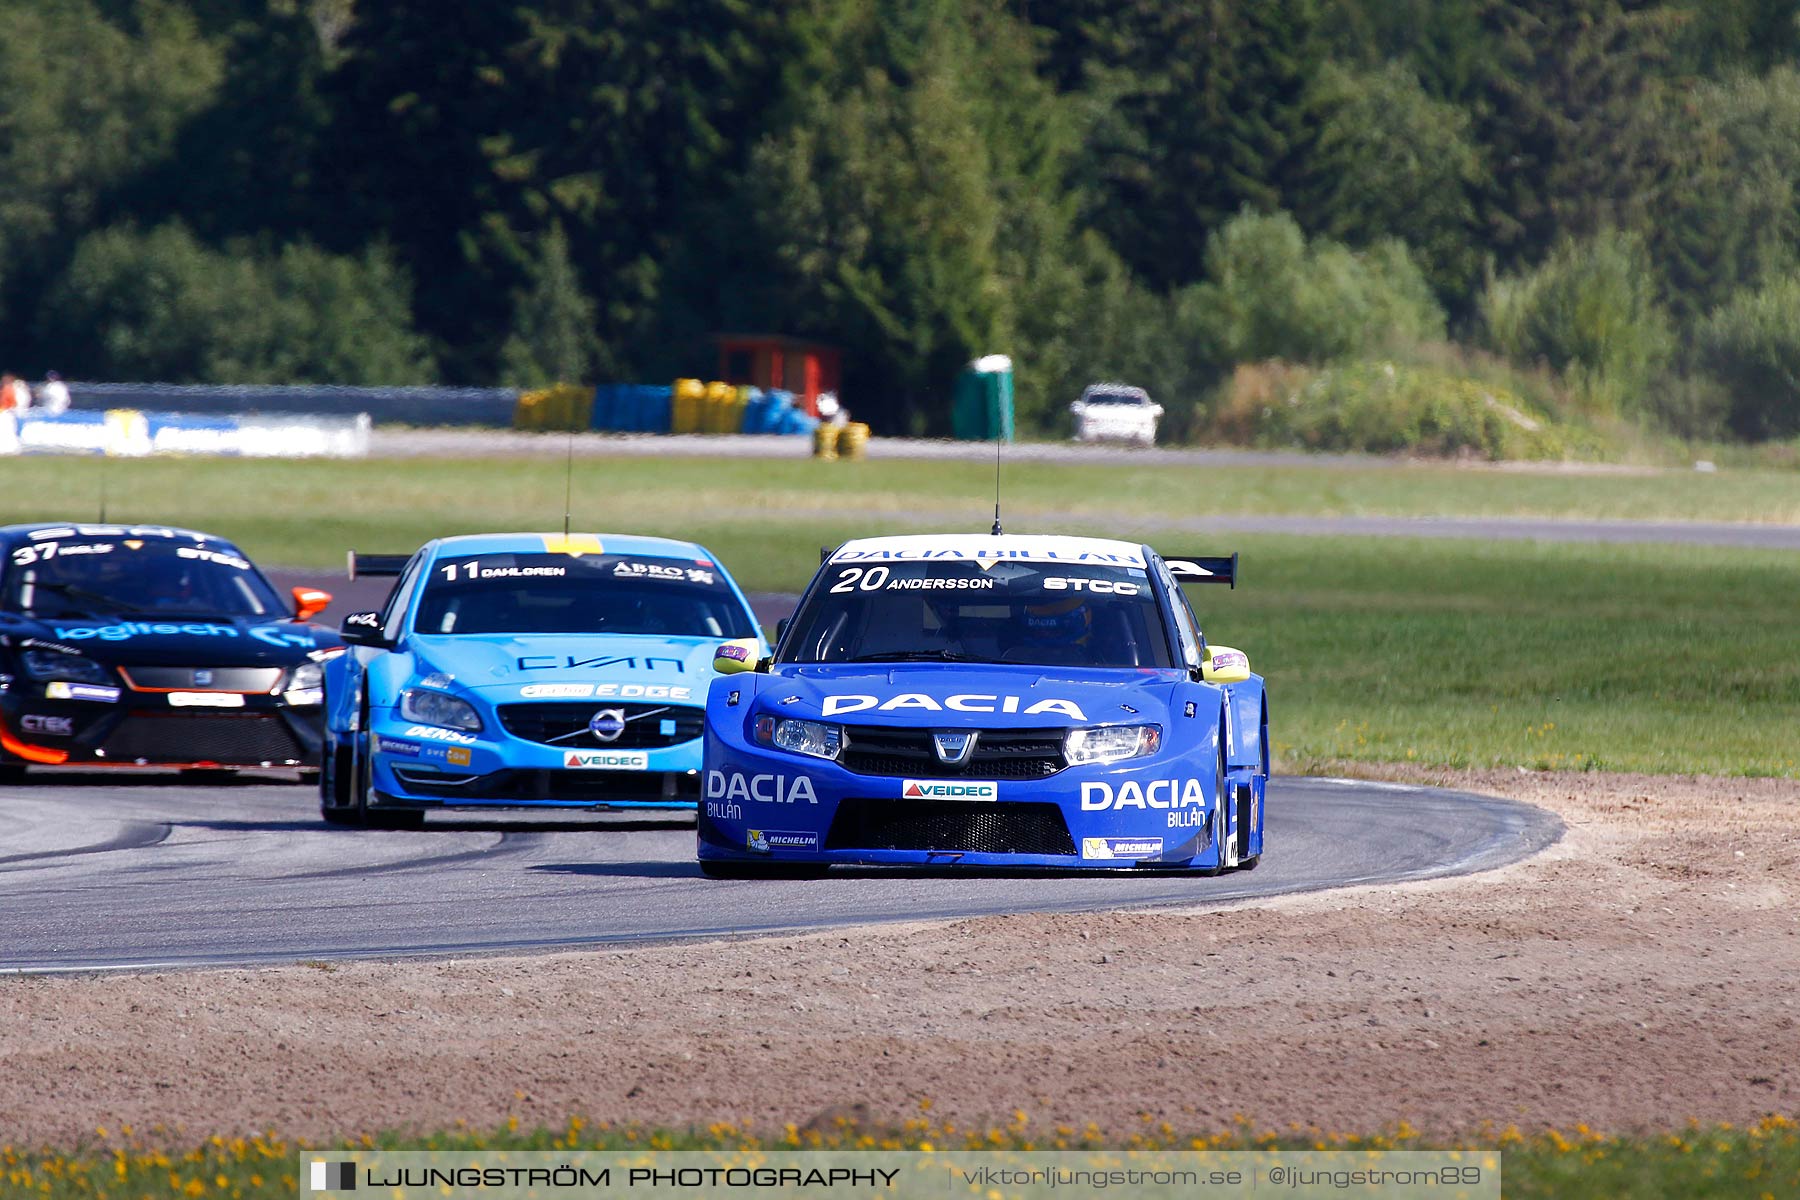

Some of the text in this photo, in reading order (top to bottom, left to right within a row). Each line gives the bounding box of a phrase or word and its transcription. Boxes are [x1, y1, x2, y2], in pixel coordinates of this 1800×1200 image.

[12, 541, 59, 566] 37
[835, 550, 965, 560] DACIA
[441, 560, 566, 581] 11 DAHLGREN
[829, 566, 994, 594] 20 ANDERSSON
[1043, 577, 1139, 596] STCC
[55, 621, 239, 641] logitech
[1028, 617, 1057, 627] DACIA
[596, 684, 693, 699] EDGE
[821, 693, 1088, 721] DACIA
[20, 714, 73, 733] CTEK
[405, 726, 477, 744] DENSO
[579, 756, 643, 766] VEIDEC
[707, 770, 819, 804] DACIA
[919, 785, 993, 797] VEIDEC
[1081, 779, 1206, 811] DACIA
[707, 800, 742, 819] BILLÅN
[1167, 807, 1206, 828] BILLÅN
[769, 836, 817, 845] MICHELIN
[1114, 843, 1161, 852] MICHELIN
